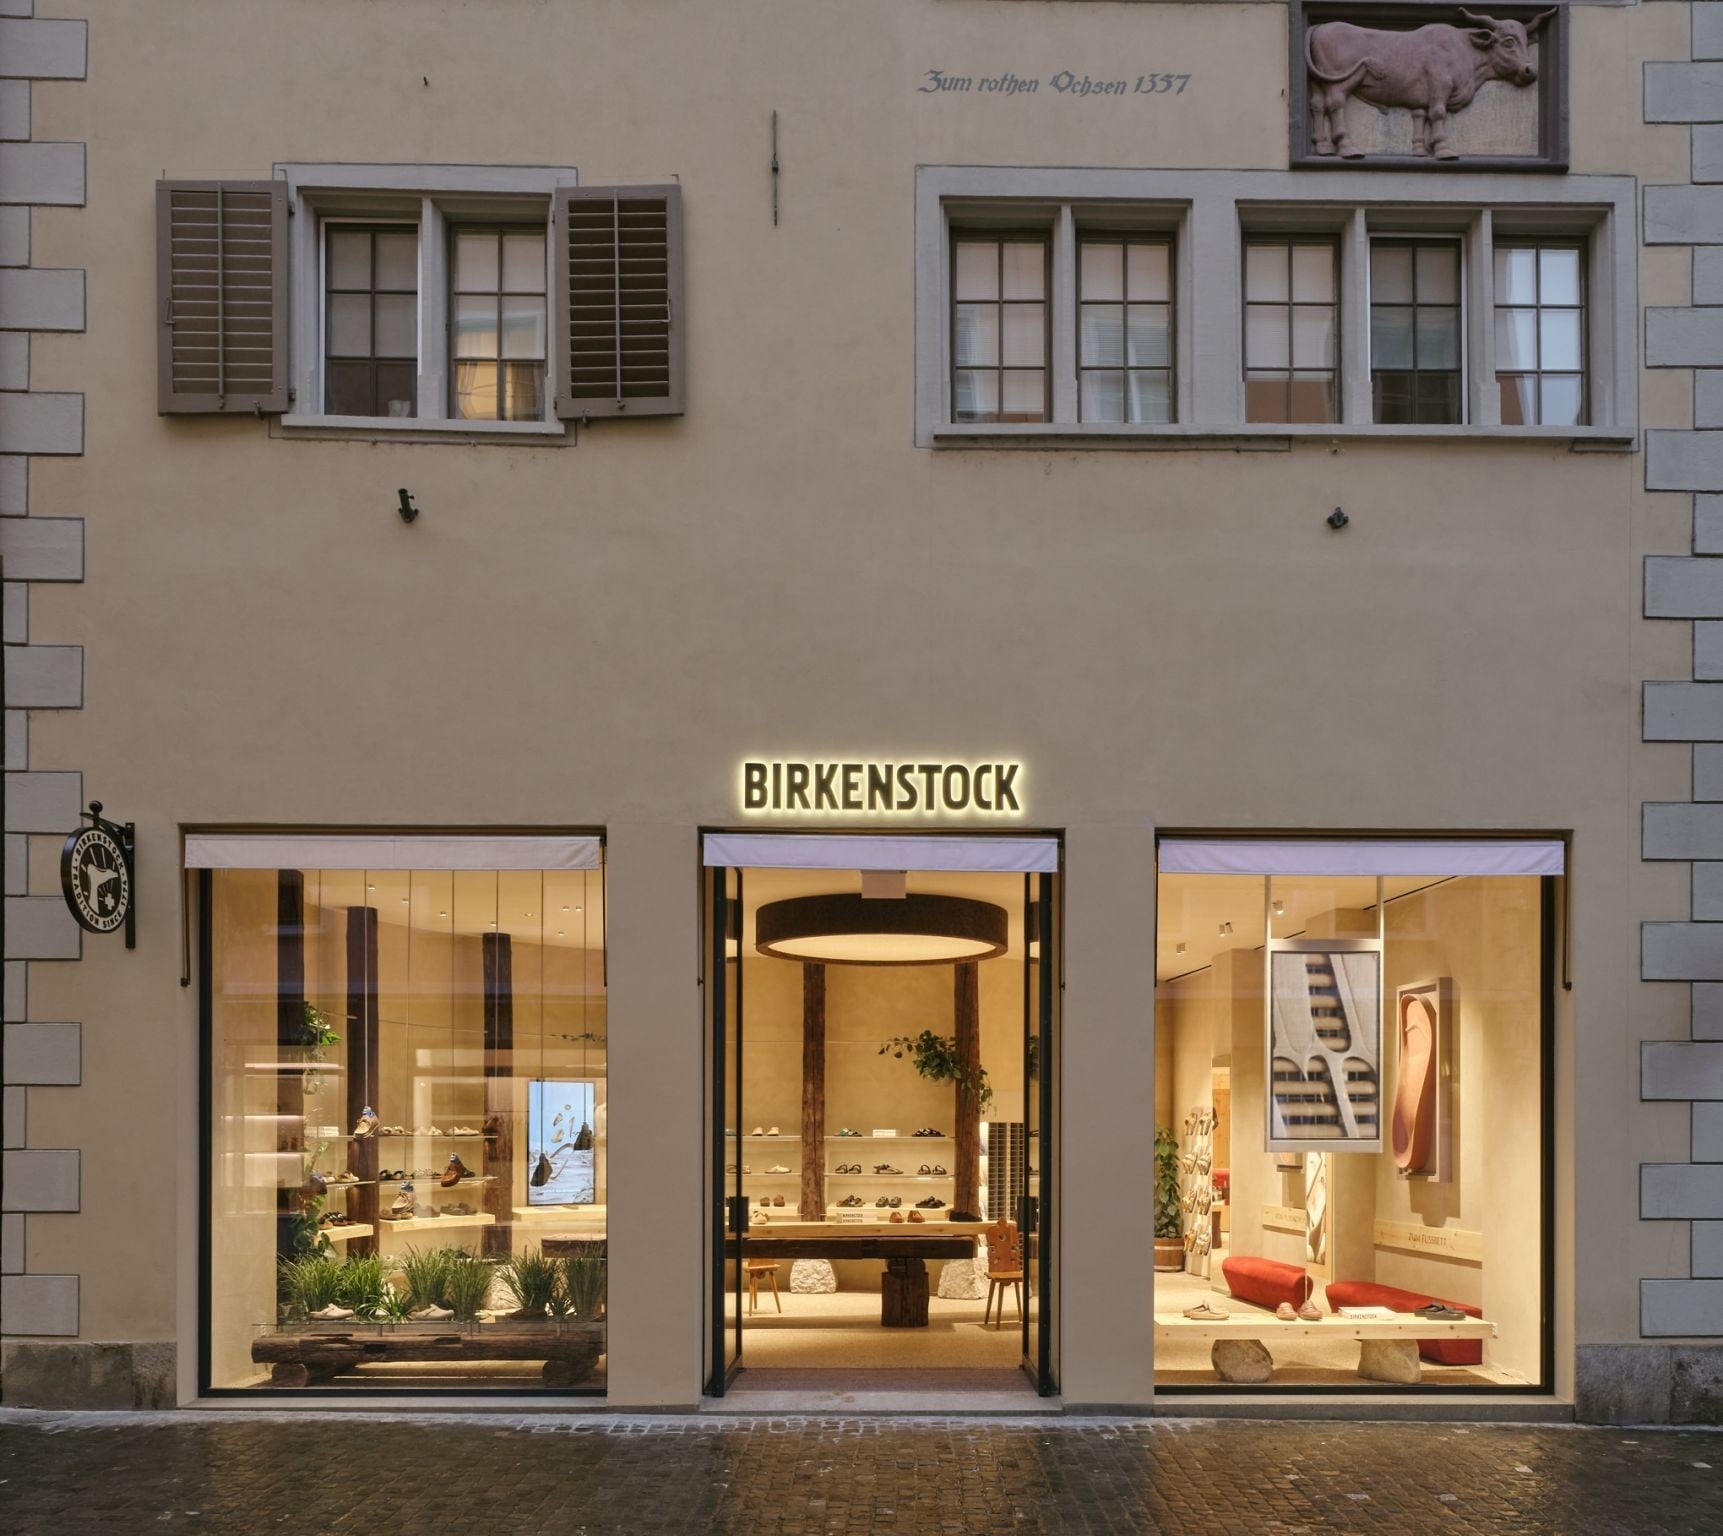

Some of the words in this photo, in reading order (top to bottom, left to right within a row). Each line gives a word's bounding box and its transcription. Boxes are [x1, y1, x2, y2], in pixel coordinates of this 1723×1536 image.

[917, 69, 972, 93] Zum
[976, 72, 1039, 96] rothen
[1048, 70, 1127, 97] Ochsen
[744, 762, 1020, 811] BIRKENSTOCK
[75, 832, 124, 869] BIRKENSTOCK
[72, 865, 100, 926] TRADITION
[102, 910, 122, 929] SINCE
